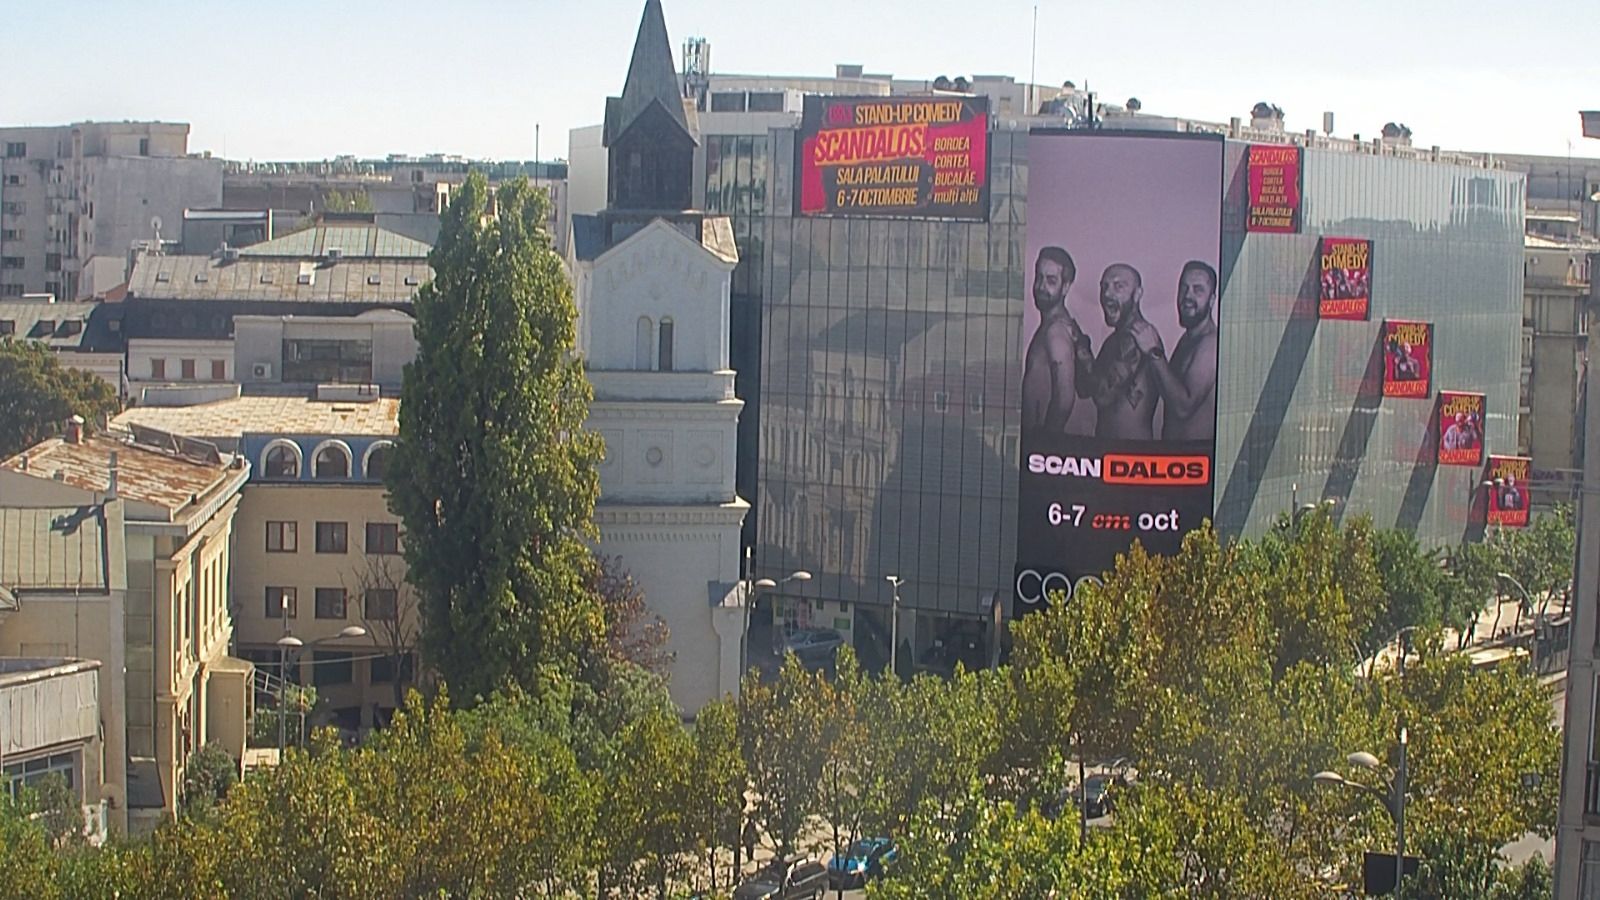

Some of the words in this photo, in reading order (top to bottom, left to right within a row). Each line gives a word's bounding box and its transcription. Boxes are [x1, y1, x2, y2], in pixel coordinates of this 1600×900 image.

[856, 103, 912, 125] STAND-UP
[914, 102, 962, 123] COMEDY
[934, 136, 970, 151] BORDEA
[935, 154, 969, 168] CORTEA
[837, 166, 863, 185] SALA
[864, 165, 919, 184] PALATULUI
[859, 187, 918, 206] OCTOMBRIE
[1322, 254, 1368, 270] COMEDY
[1048, 503, 1086, 527] 6-7
[1138, 508, 1179, 531] oct
